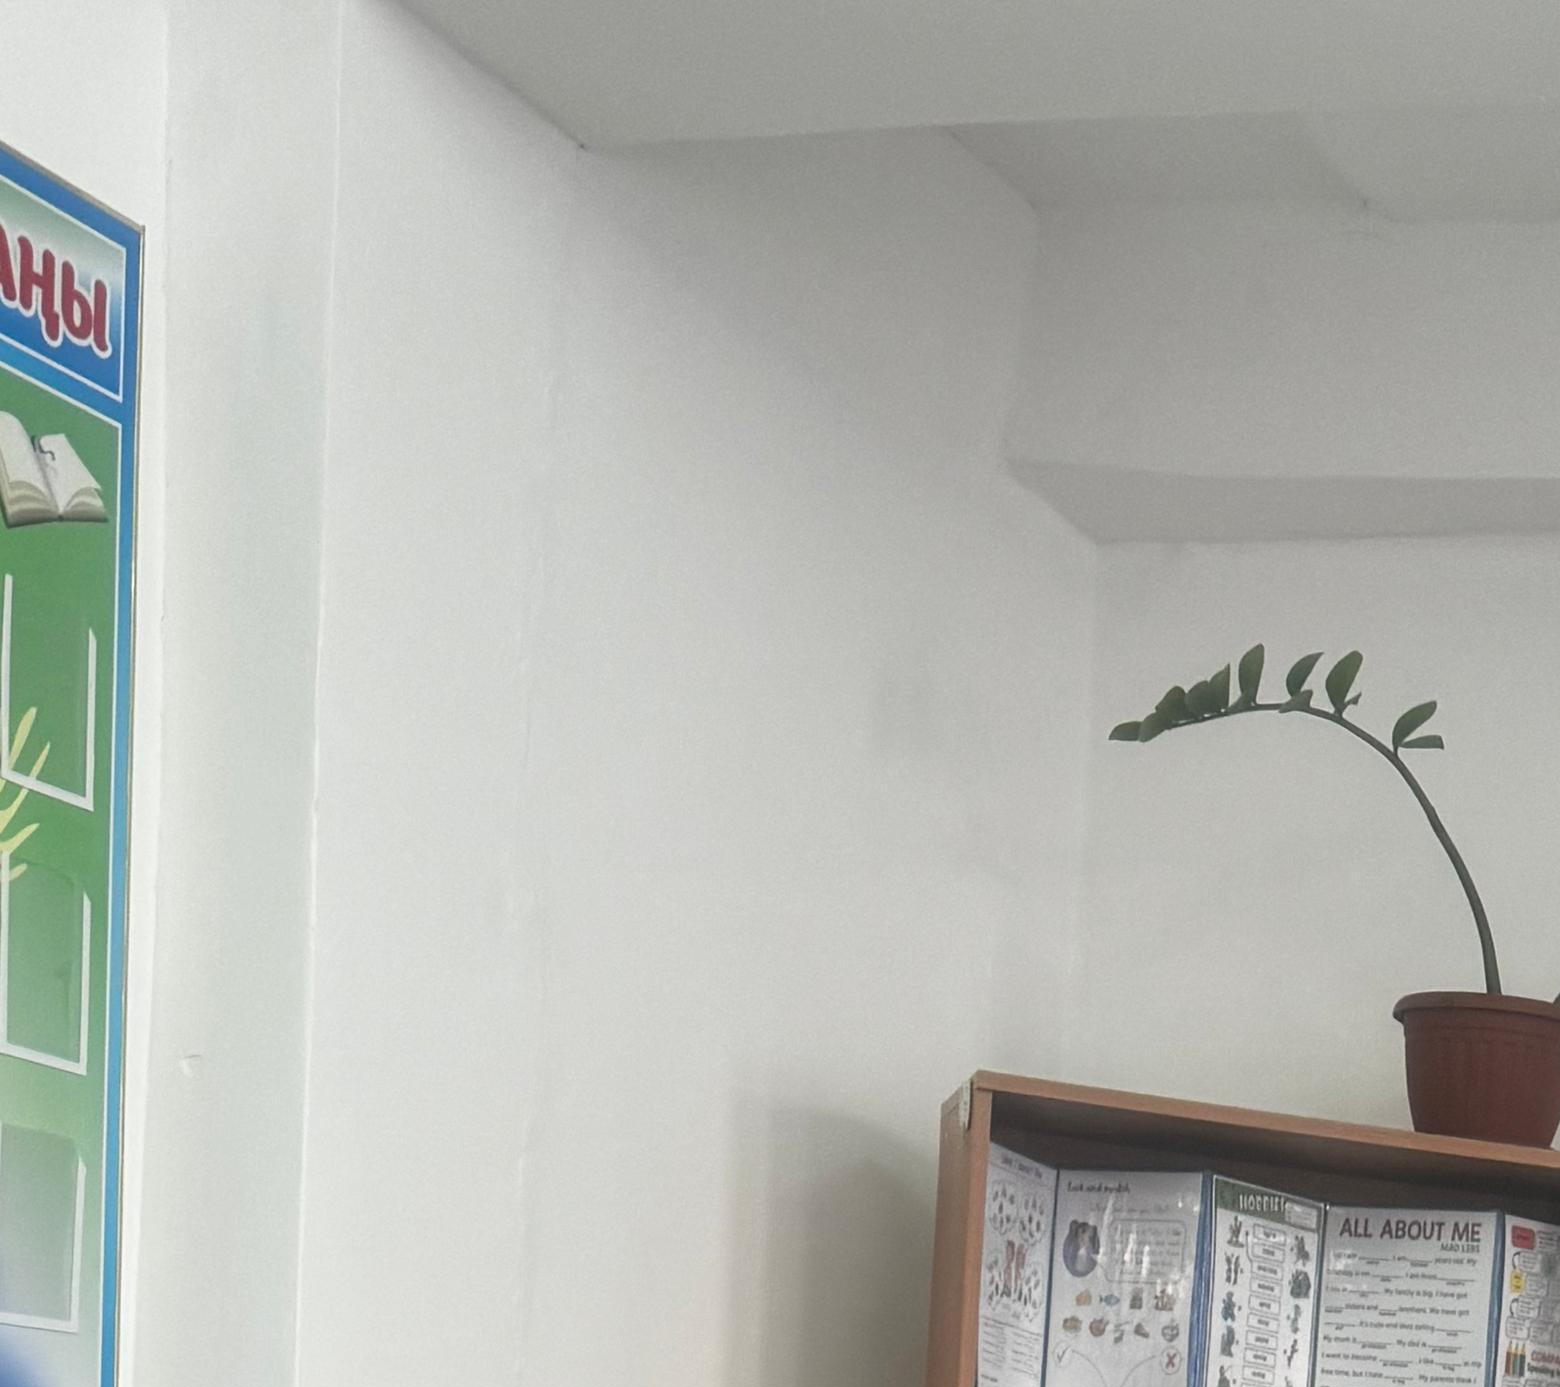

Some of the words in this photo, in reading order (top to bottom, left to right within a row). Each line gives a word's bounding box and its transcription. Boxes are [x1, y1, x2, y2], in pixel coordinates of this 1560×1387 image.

[1339, 1217, 1373, 1238] ALL
[1380, 1218, 1446, 1242] ABOUT
[1451, 1221, 1482, 1243] ME
